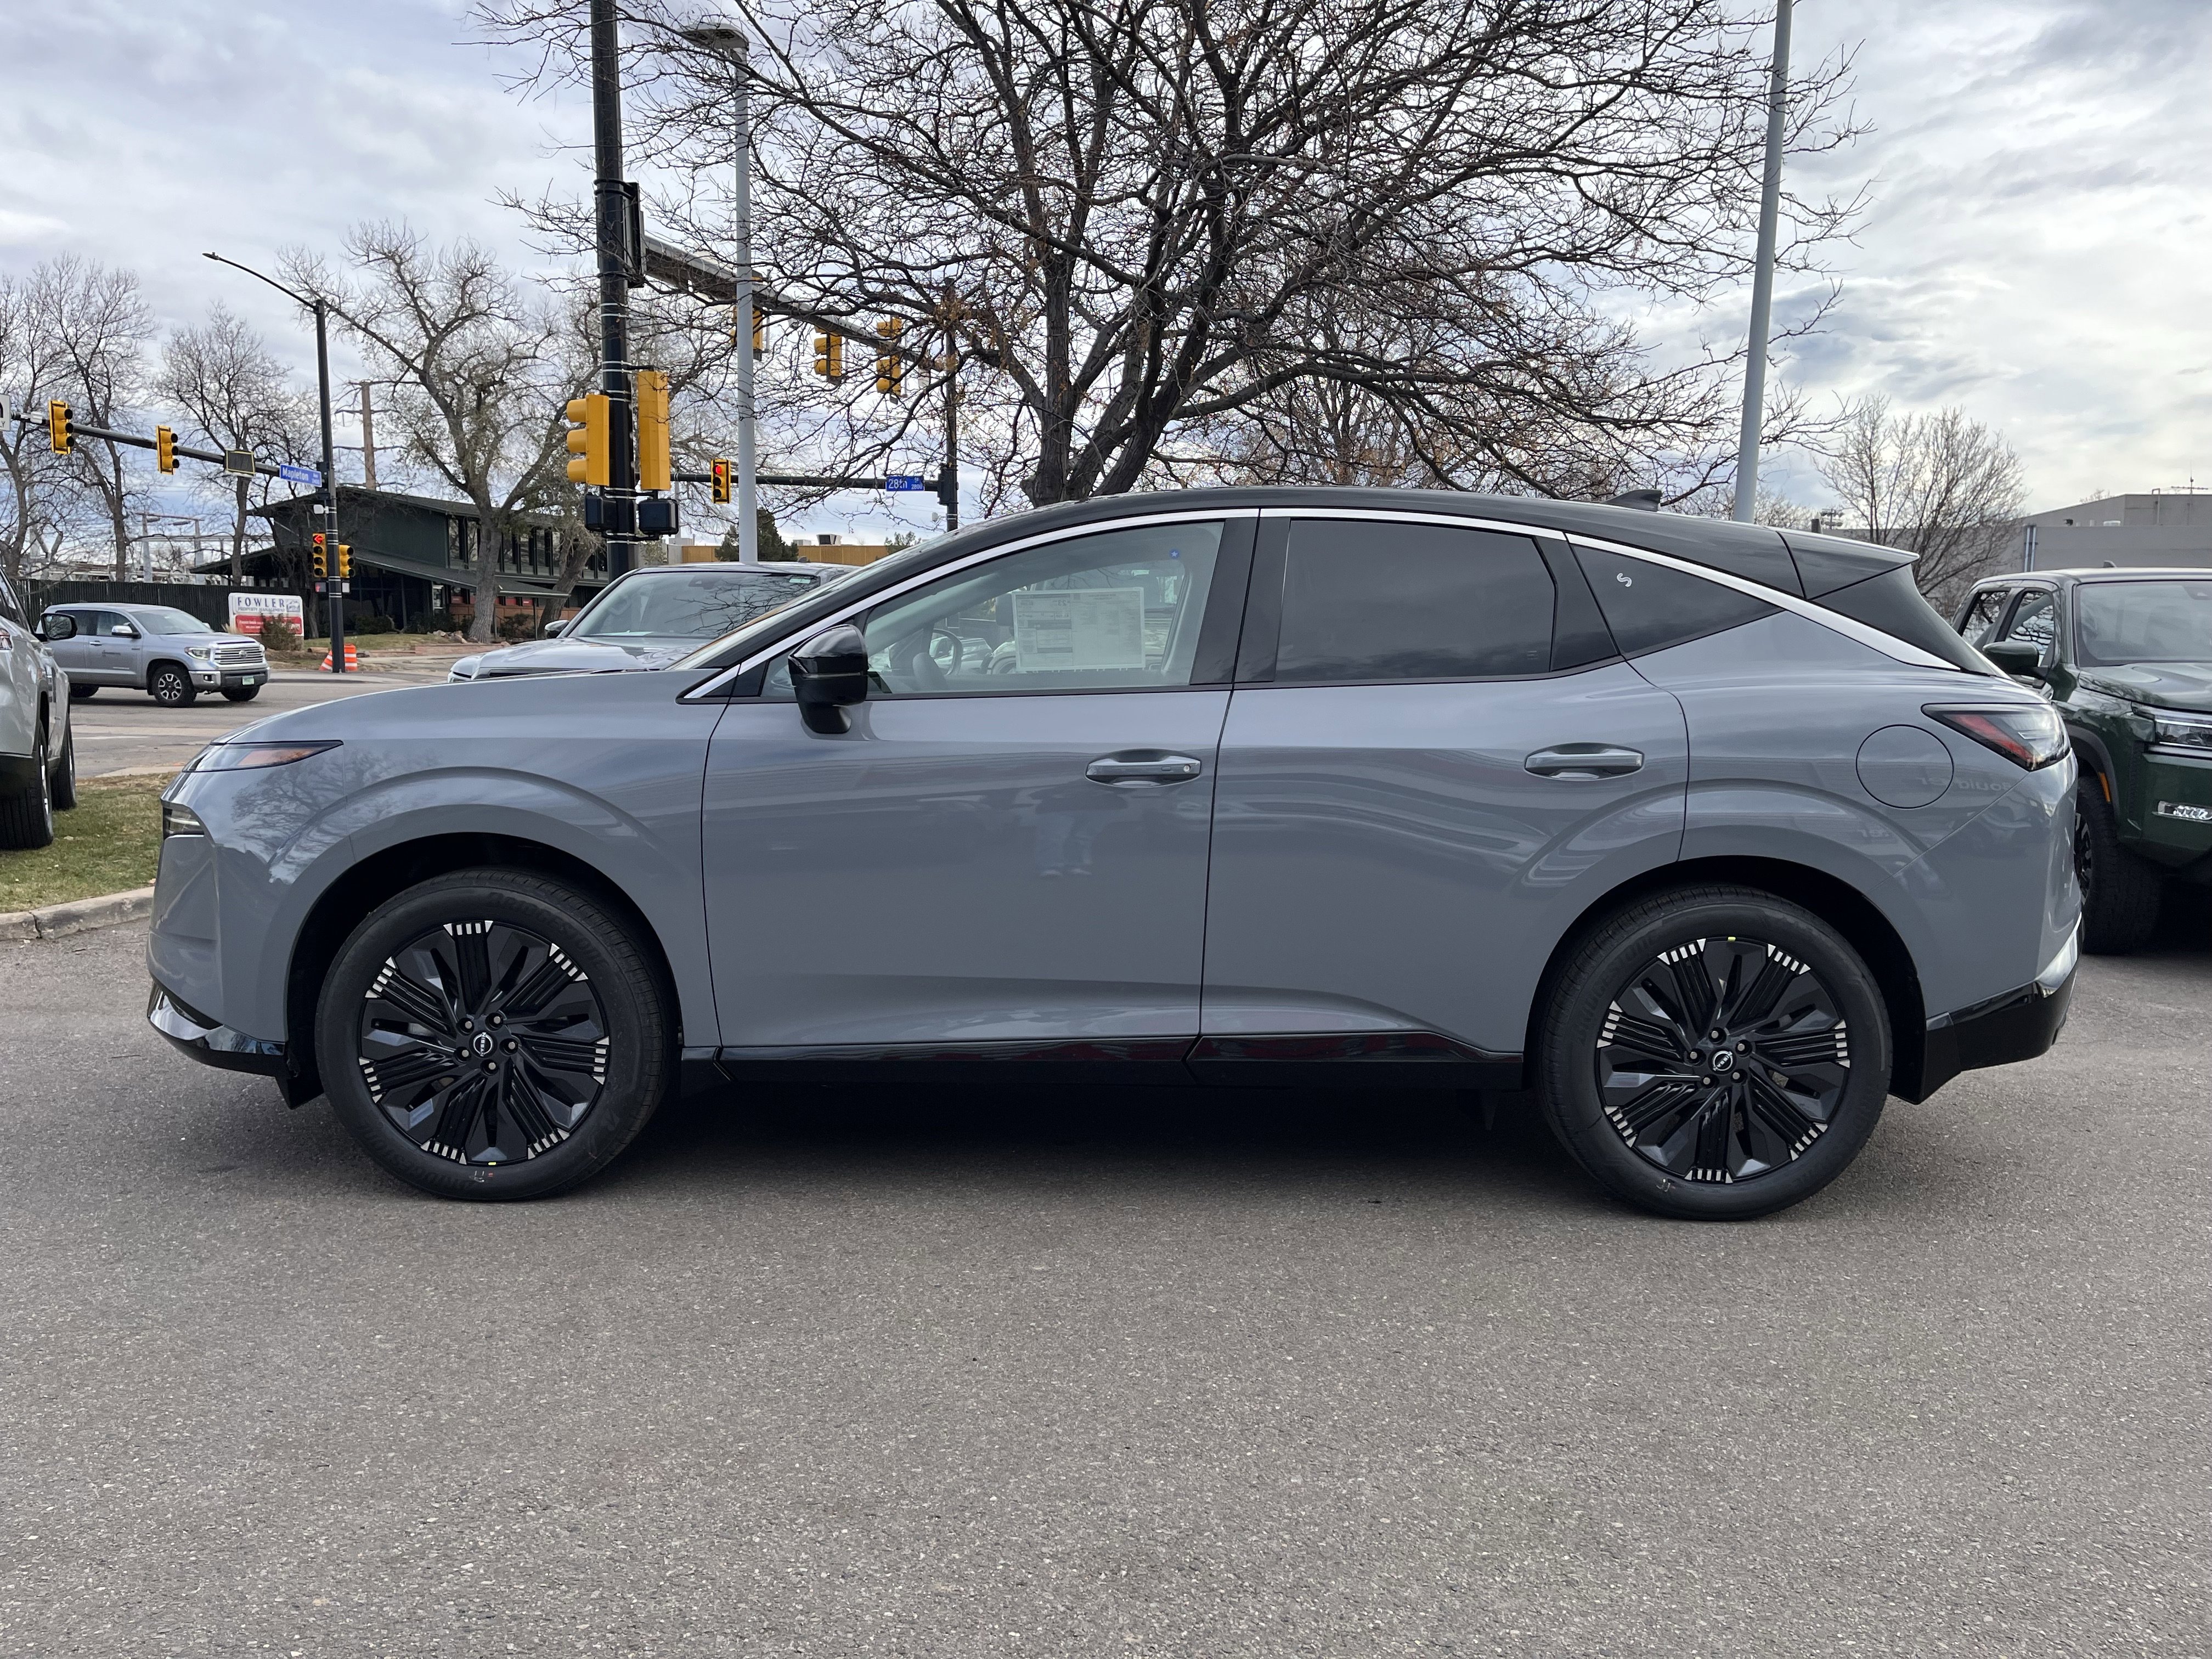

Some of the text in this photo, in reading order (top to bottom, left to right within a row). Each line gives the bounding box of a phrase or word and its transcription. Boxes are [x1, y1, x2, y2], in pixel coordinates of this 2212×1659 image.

[282, 467, 309, 481] Mapleton
[888, 478, 907, 489] 28th
[238, 597, 284, 608] FOWLER
